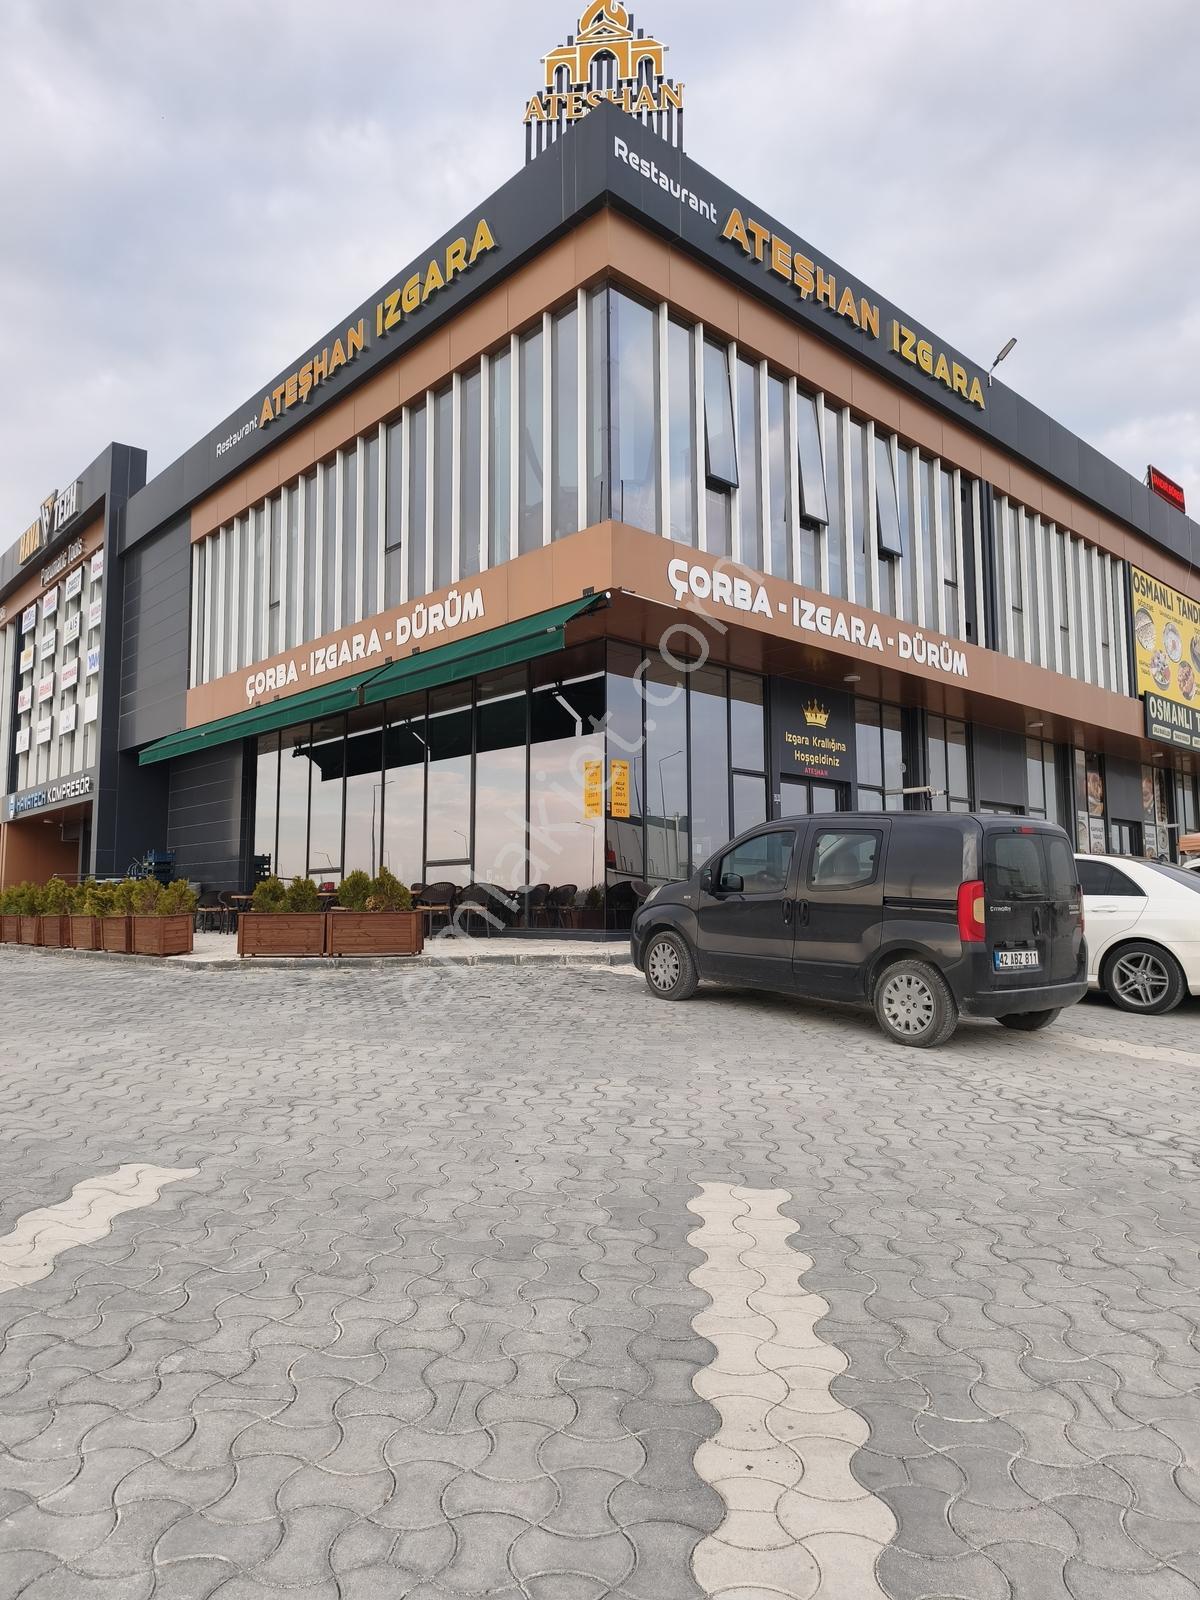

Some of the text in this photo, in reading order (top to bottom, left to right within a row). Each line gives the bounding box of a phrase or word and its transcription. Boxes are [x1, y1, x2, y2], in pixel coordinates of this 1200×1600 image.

[614, 135, 986, 411] Restaurant ATEŞHAN IZGARA
[216, 218, 496, 458] Restaurant ATEŞHAN IZGARA
[1133, 571, 1174, 612] OSMANLI
[667, 558, 774, 619] ÇORBA
[792, 597, 884, 651] IZGARA
[898, 631, 969, 678] DÜRÜM
[245, 660, 299, 704] ÇORBA
[310, 628, 382, 676] IZGARA
[396, 588, 485, 646] DÜRÜM
[1149, 696, 1193, 730] OSMANLI
[785, 731, 810, 746] Izgara
[794, 750, 840, 767] Hoşgeldiniz
[1000, 952, 1038, 966] 42 ABZ 811
